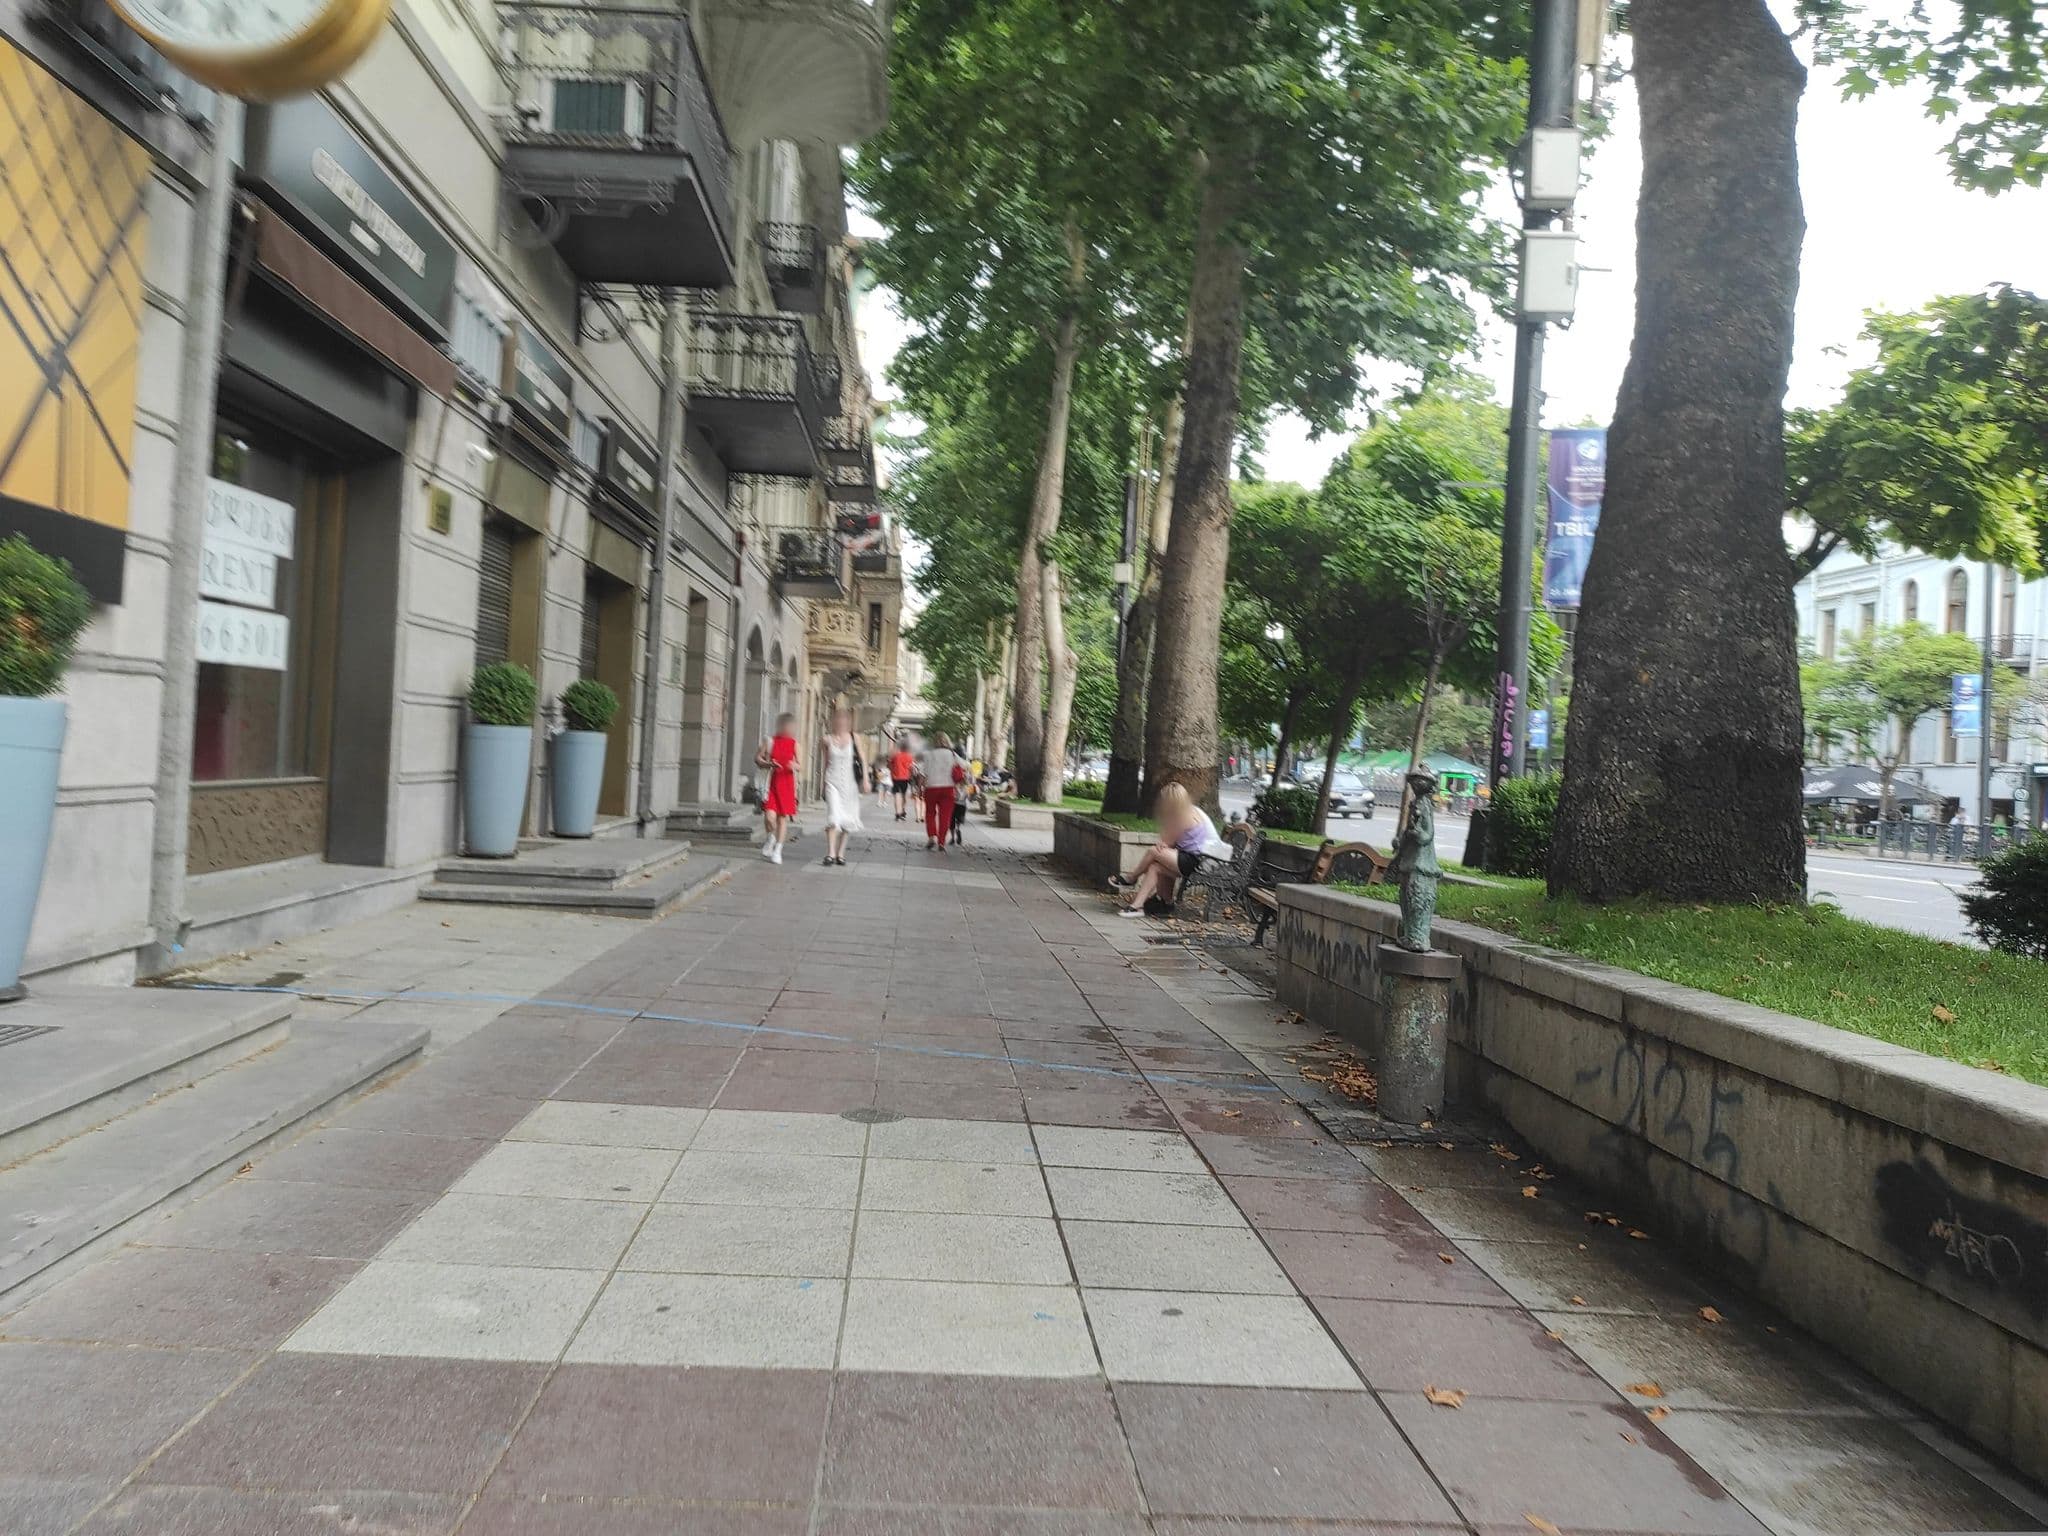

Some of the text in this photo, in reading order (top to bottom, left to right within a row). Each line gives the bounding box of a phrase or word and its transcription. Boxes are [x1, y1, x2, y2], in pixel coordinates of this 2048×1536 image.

[1554, 521, 1596, 537] TBIL
[201, 547, 275, 597] RENT
[200, 612, 282, 659] 66301
